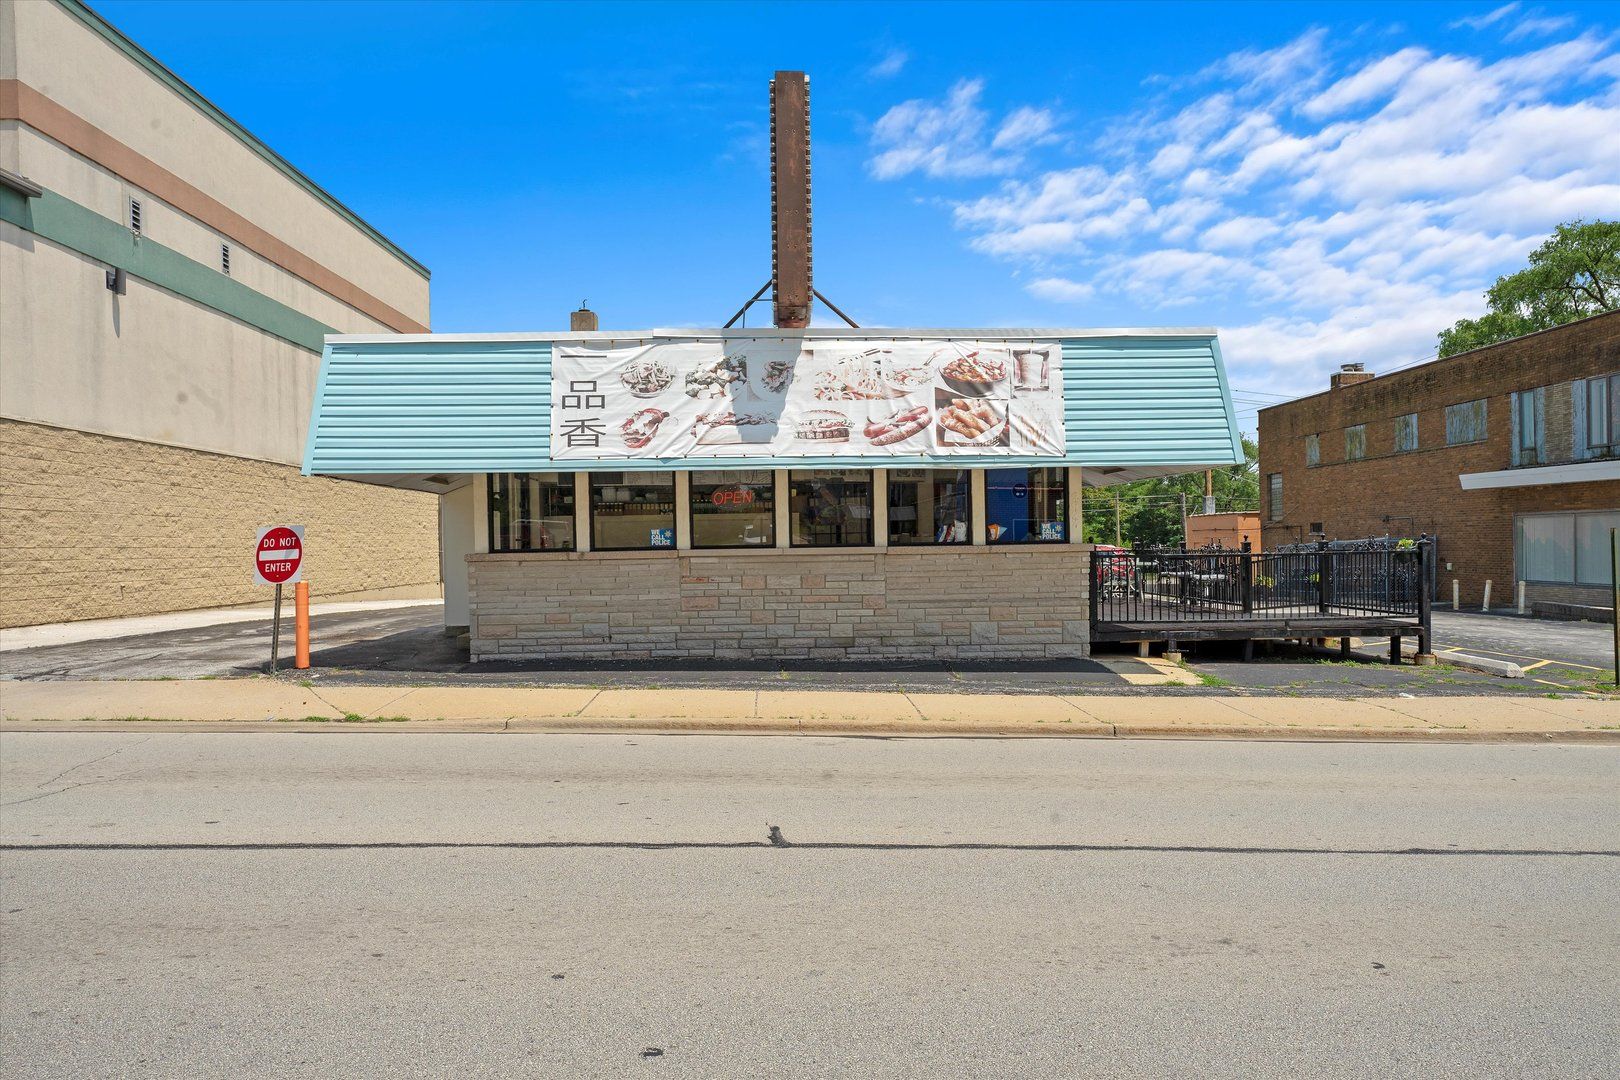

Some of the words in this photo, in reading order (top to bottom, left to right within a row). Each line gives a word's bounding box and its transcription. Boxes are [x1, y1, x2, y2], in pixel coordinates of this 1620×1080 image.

[560, 355, 607, 447] 一品香
[713, 490, 753, 505] OPEN
[263, 538, 276, 548] DO
[279, 537, 297, 547] NOT
[265, 562, 291, 573] ENTER
